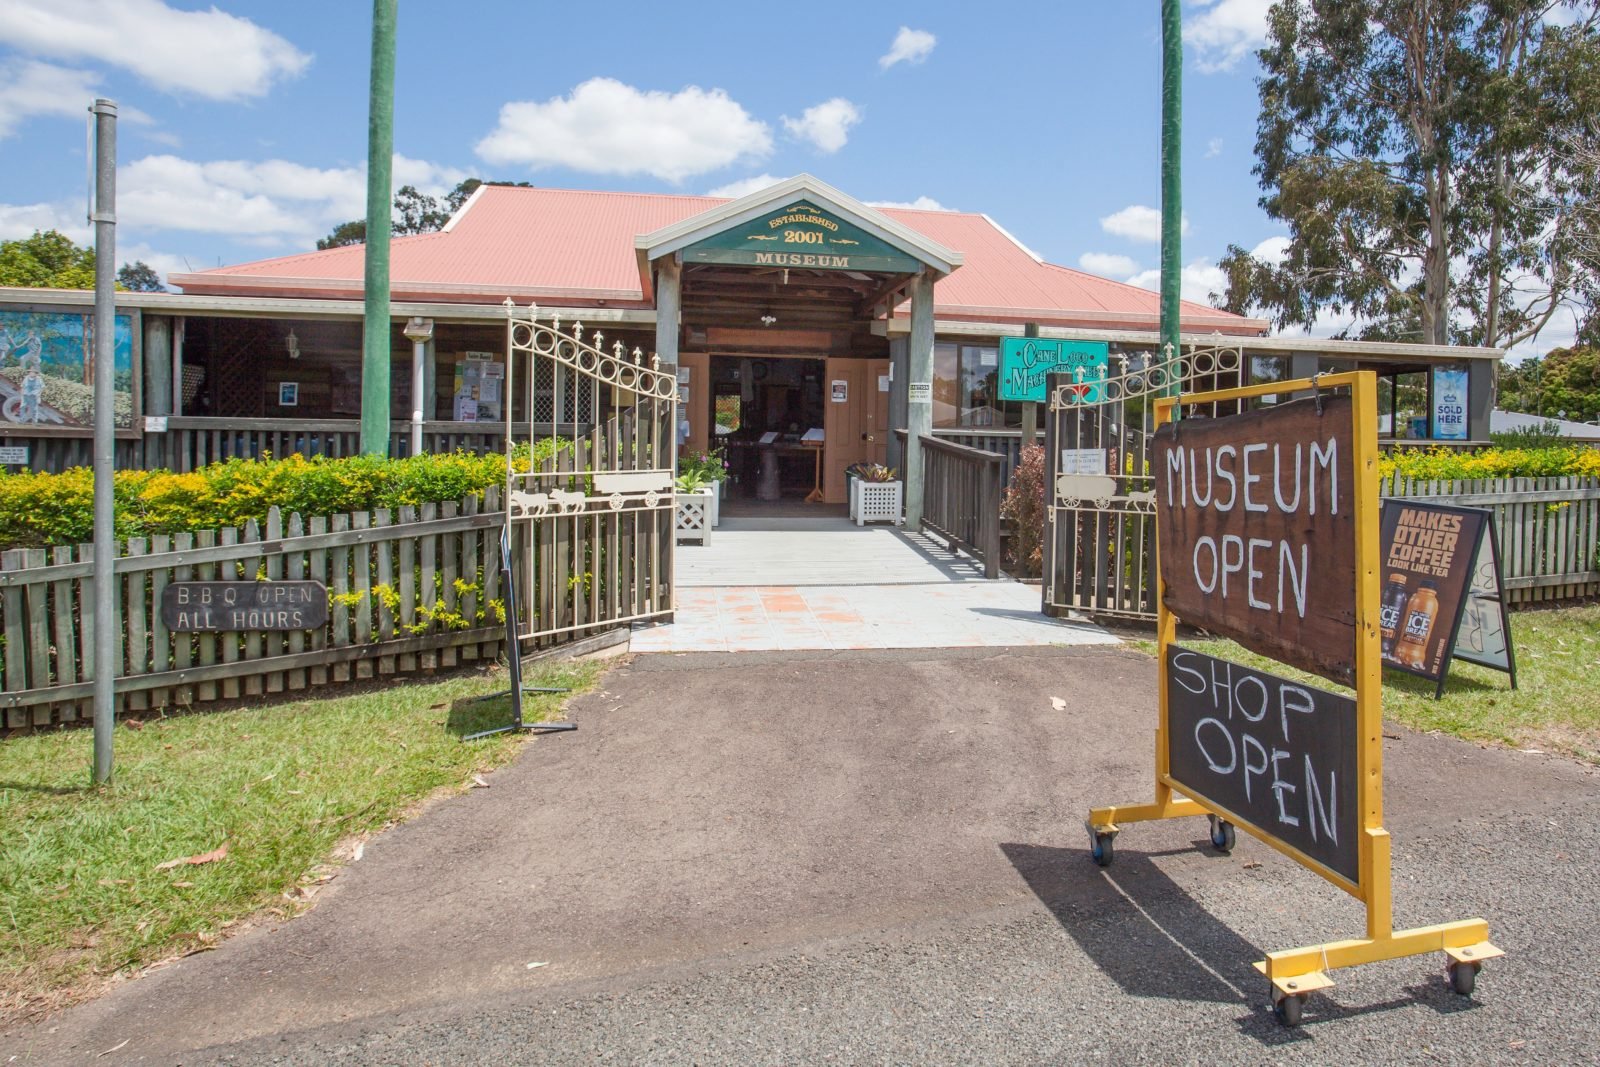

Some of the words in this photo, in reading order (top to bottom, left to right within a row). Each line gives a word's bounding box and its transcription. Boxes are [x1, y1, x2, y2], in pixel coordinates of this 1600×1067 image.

[768, 214, 839, 232] ESTABLISHED
[784, 230, 824, 244] 2001
[755, 252, 849, 268] MUSEUM
[1438, 405, 1462, 414] SOLD
[1438, 415, 1462, 423] HERE
[1166, 436, 1338, 515] MUSEUM
[1398, 508, 1463, 533] MAKES
[1394, 525, 1458, 552] OTHER
[1389, 543, 1454, 569] COFFEE
[1193, 534, 1308, 618] OPEN
[1387, 558, 1410, 570] LOOK
[1411, 562, 1430, 575] LIKE
[1431, 567, 1449, 577] TEA
[260, 587, 312, 603] OPEN
[177, 611, 216, 629] ALL
[233, 611, 303, 628] HOURS
[1407, 614, 1431, 630] ICE
[1173, 652, 1316, 743] SHOP
[1195, 717, 1338, 846] OPEN
